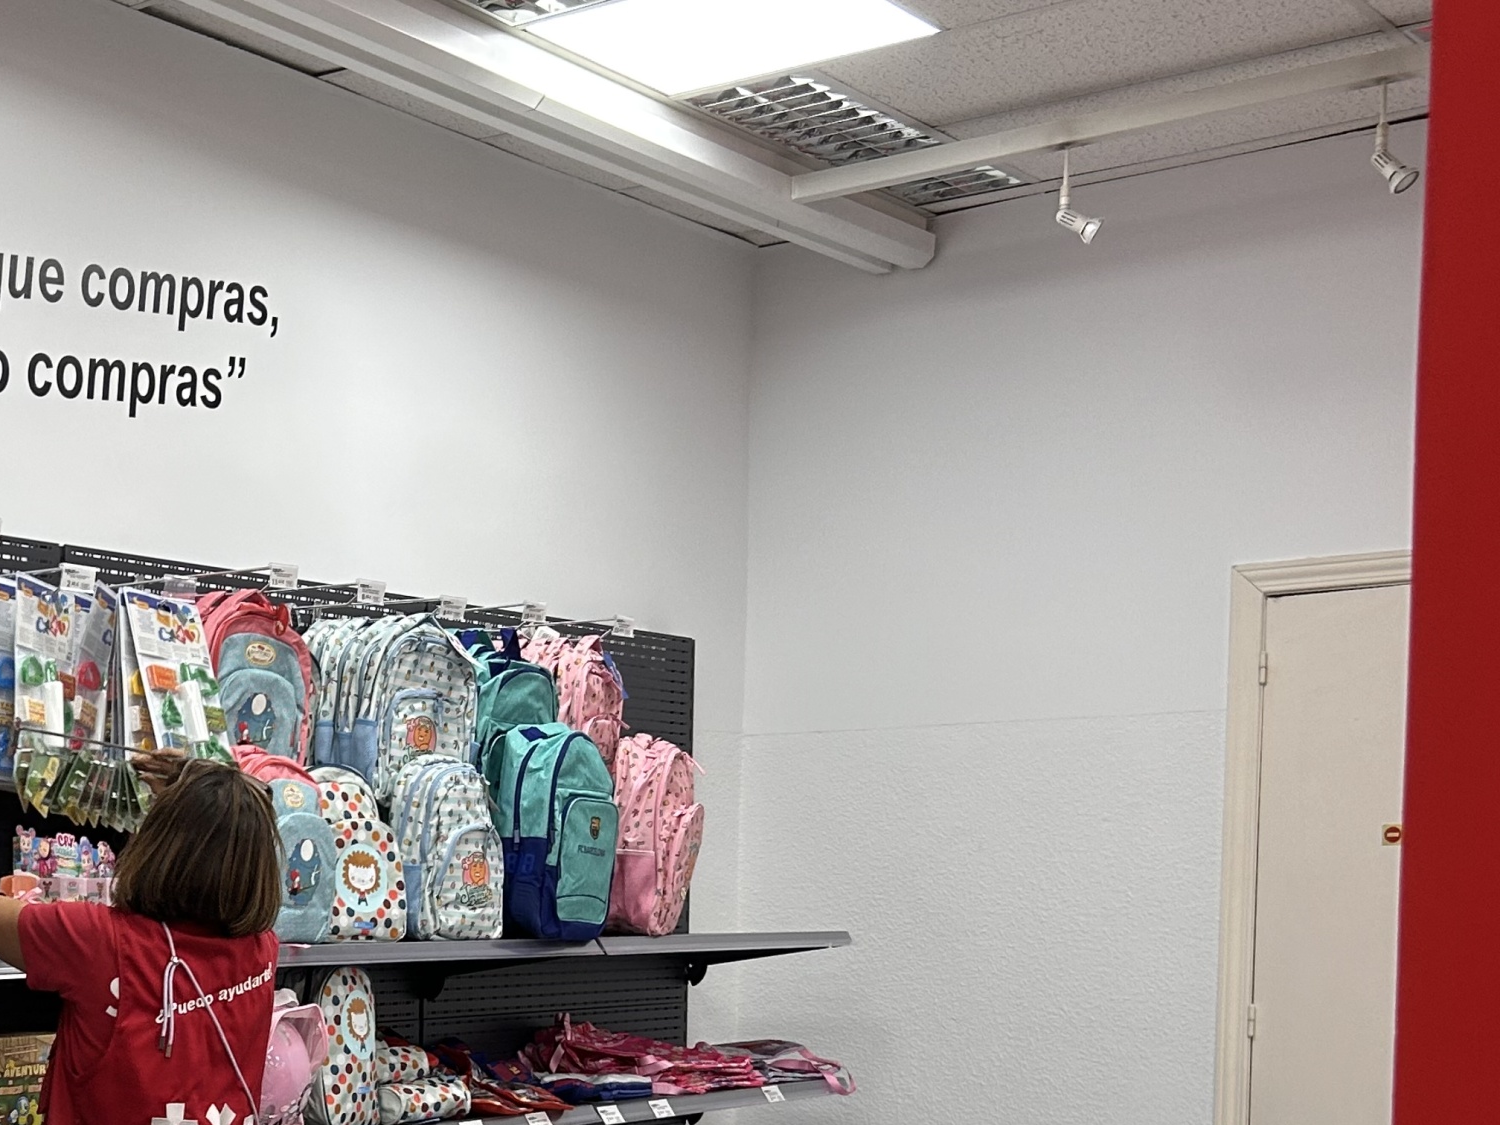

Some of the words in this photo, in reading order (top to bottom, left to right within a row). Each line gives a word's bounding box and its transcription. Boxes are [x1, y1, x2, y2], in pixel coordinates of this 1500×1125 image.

[81, 263, 279, 338] compras,
[27, 353, 246, 418] compras”
[4, 1064, 47, 1078] AVENTUR
